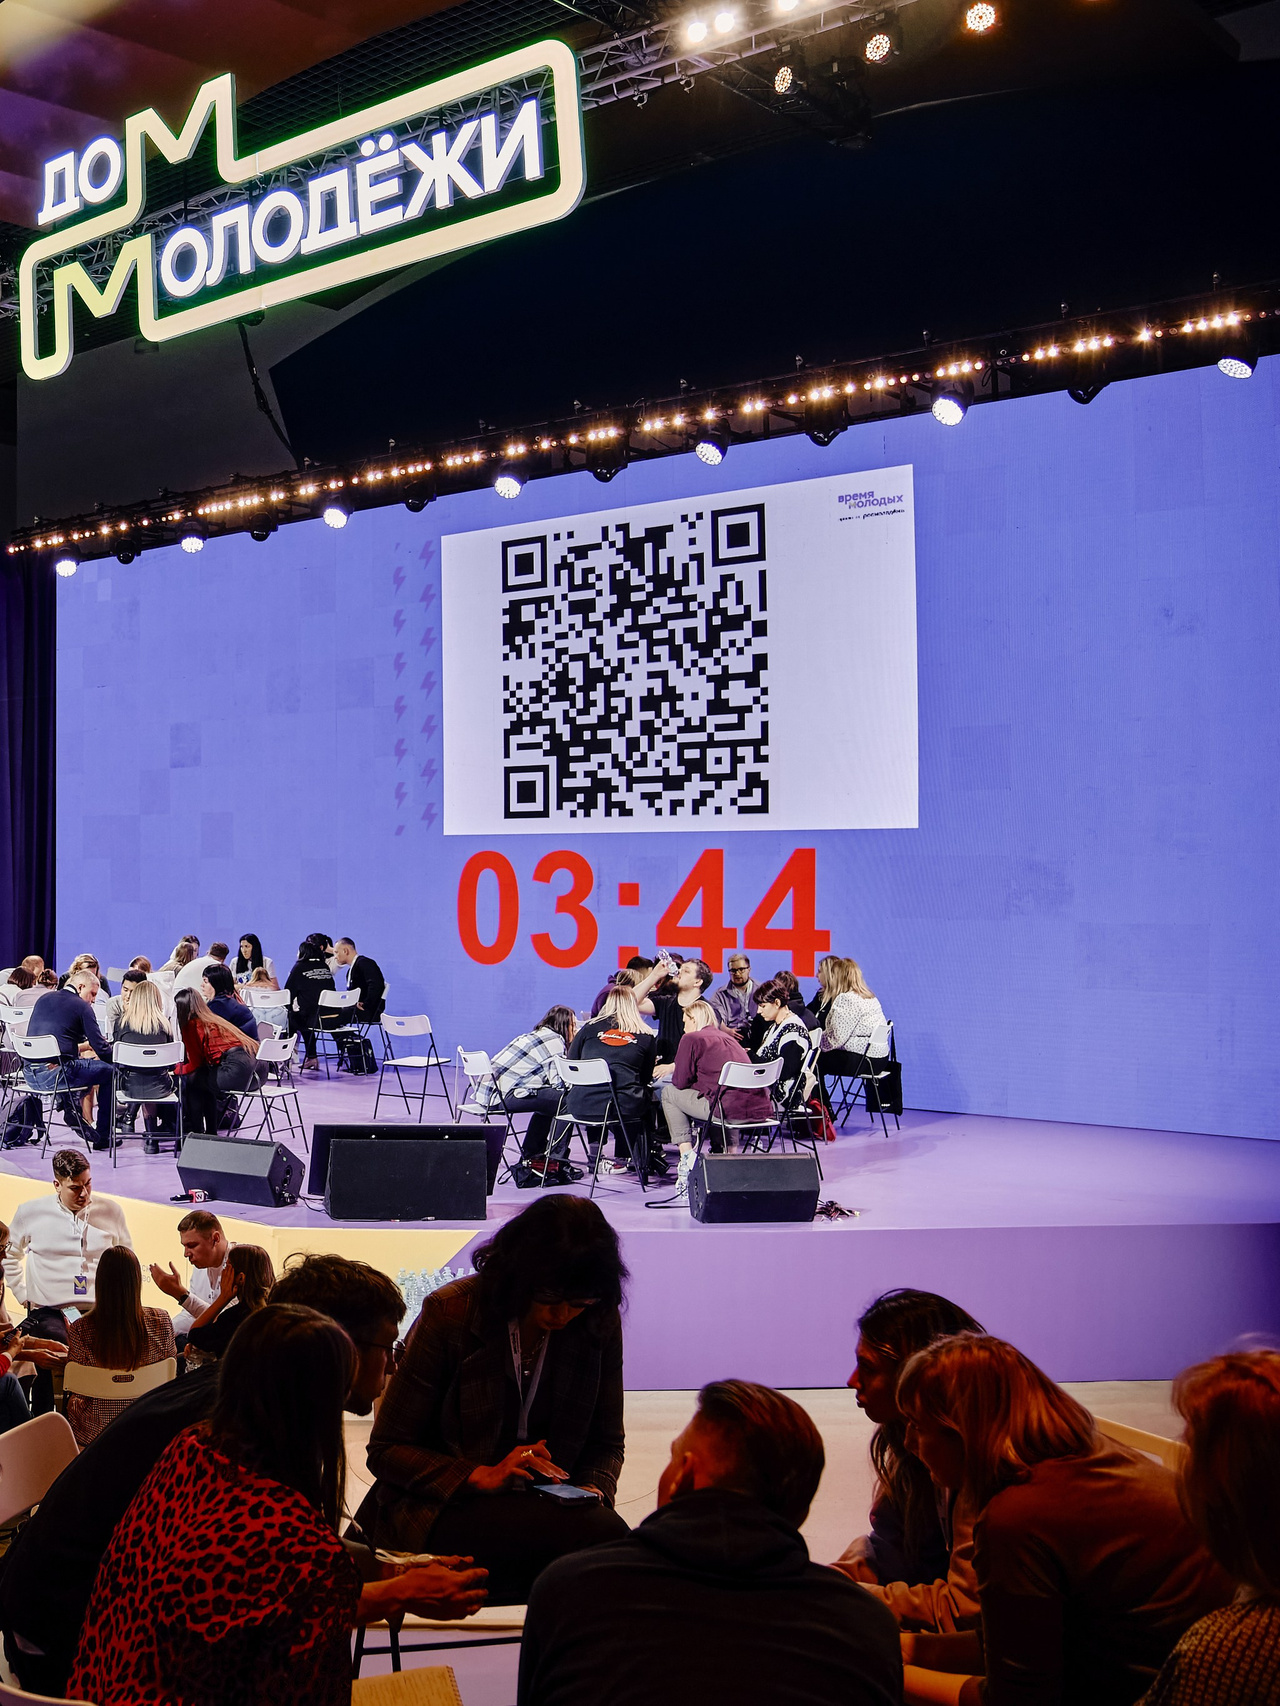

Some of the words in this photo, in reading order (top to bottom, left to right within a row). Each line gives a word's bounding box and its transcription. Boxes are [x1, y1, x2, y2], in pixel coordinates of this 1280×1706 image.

[37, 71, 239, 228] ДОМ
[38, 98, 544, 376] МОЛОДЁЖИ
[838, 491, 874, 504] время
[849, 495, 903, 509] молодых
[456, 847, 832, 978] 03:44
